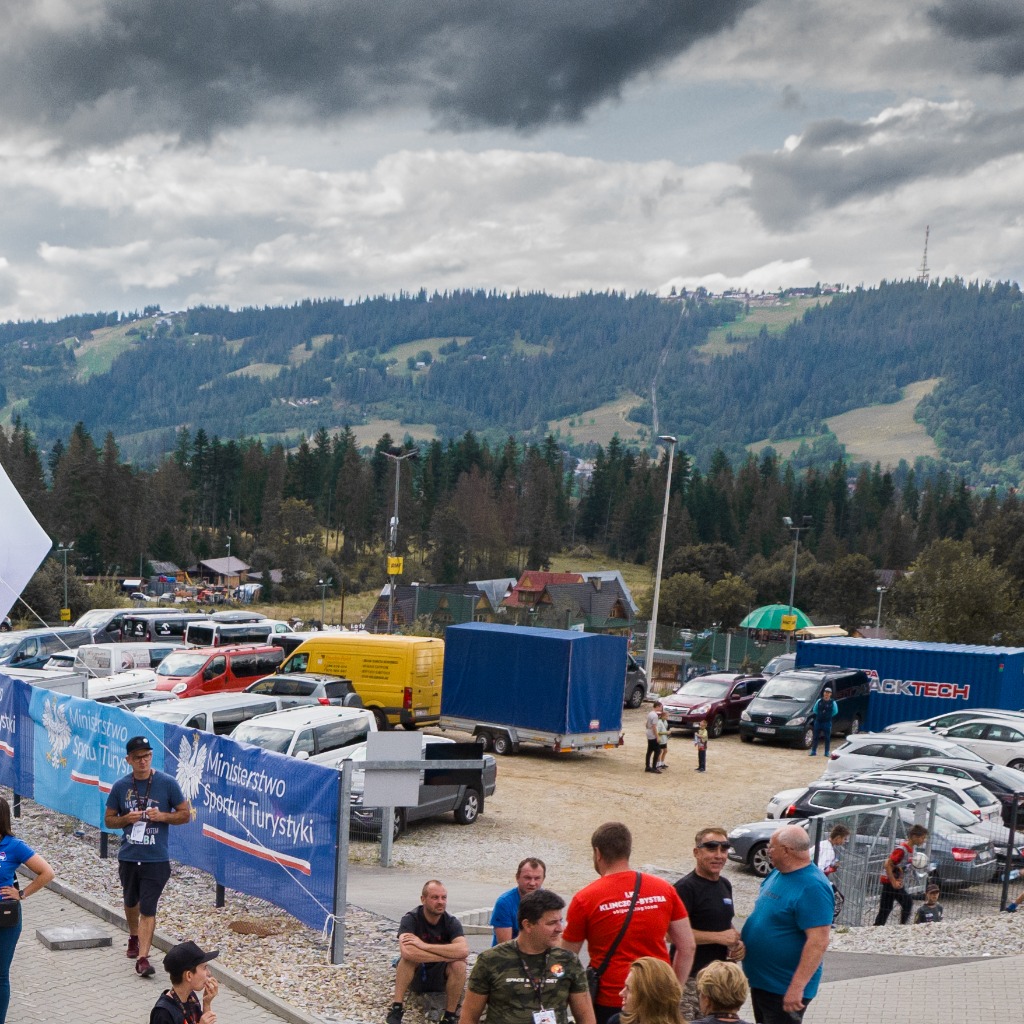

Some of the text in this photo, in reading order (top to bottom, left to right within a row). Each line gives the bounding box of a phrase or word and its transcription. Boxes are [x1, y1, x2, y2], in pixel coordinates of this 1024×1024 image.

[869, 678, 971, 701] ACKTECH
[206, 749, 286, 798] Ministerstwo
[202, 783, 314, 844] Sportu i Turystyki
[145, 827, 159, 835] OTEM
[599, 895, 667, 912] KLIMCZO-BYSTRA
